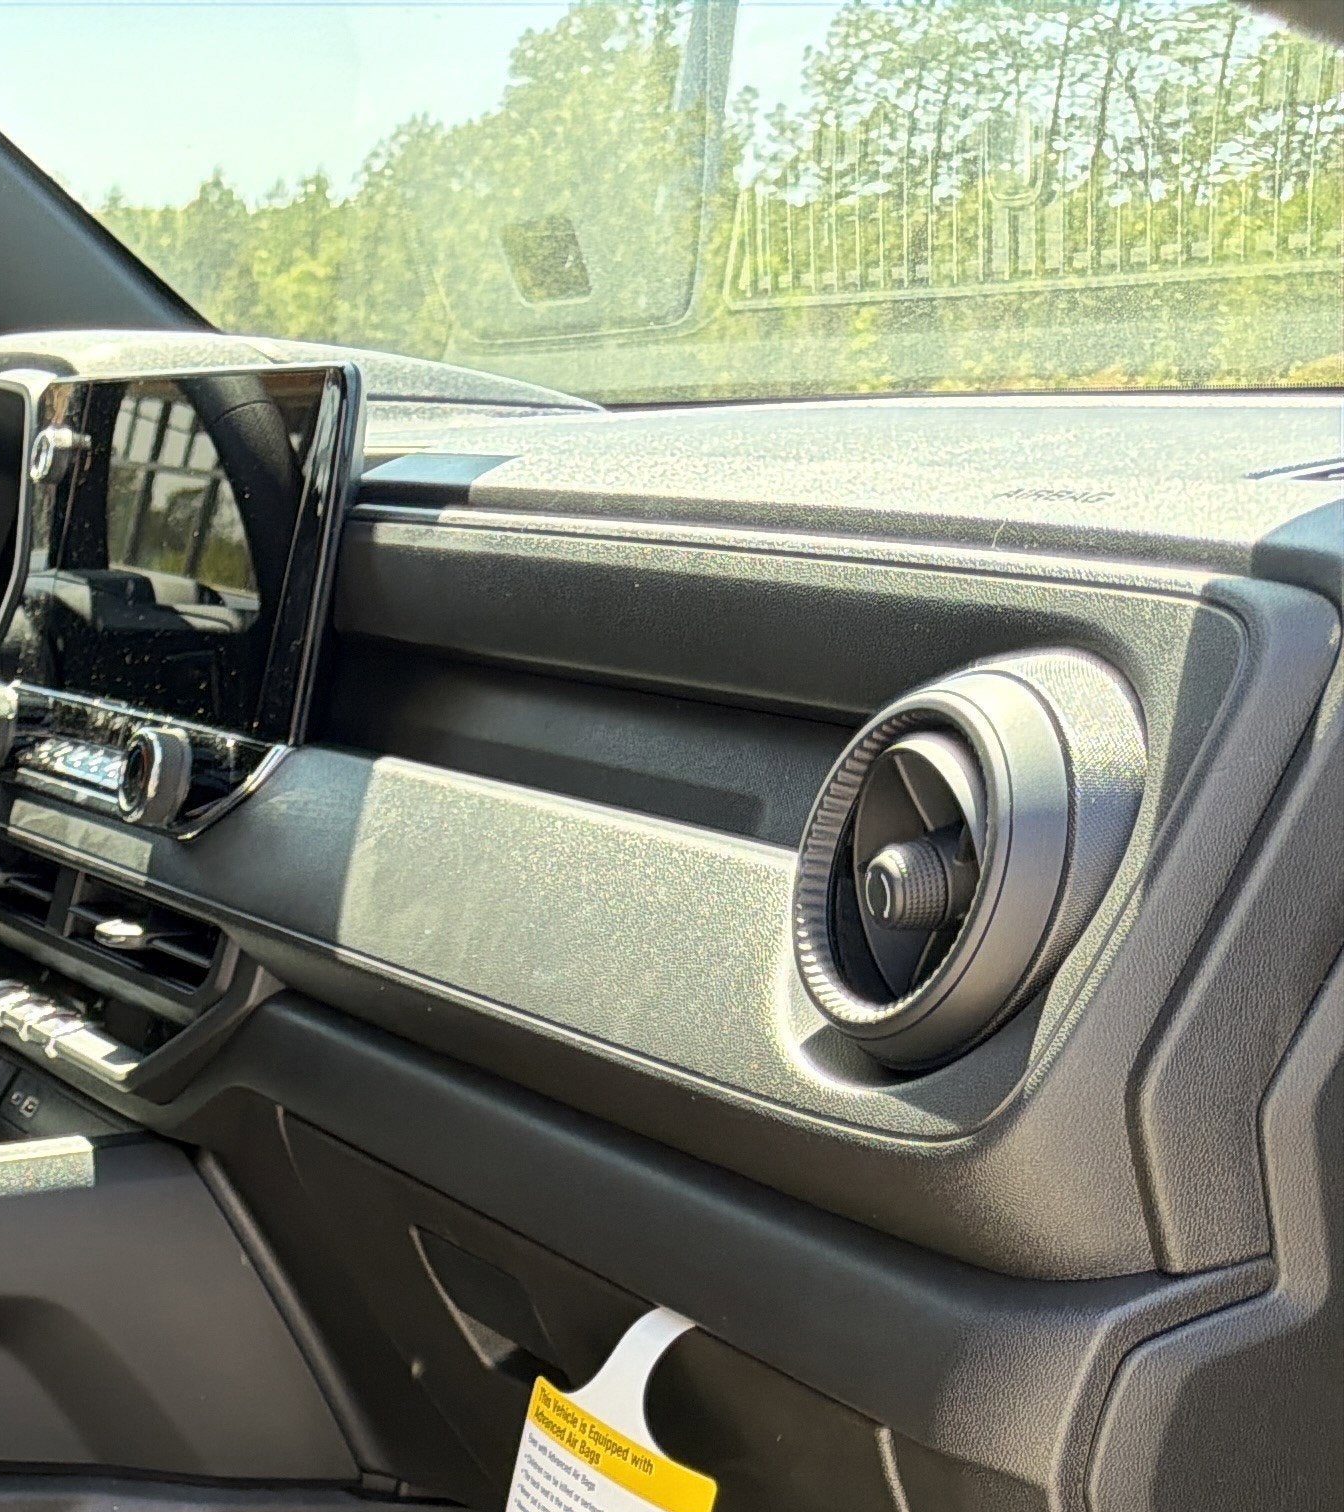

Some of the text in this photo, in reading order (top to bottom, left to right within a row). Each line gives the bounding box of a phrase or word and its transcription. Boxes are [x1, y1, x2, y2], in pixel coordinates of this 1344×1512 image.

[990, 488, 1116, 504] AIRBAG
[534, 1405, 601, 1466] Advanced Air Bags
[538, 1386, 654, 1476] This Vehicle is Equipped with
